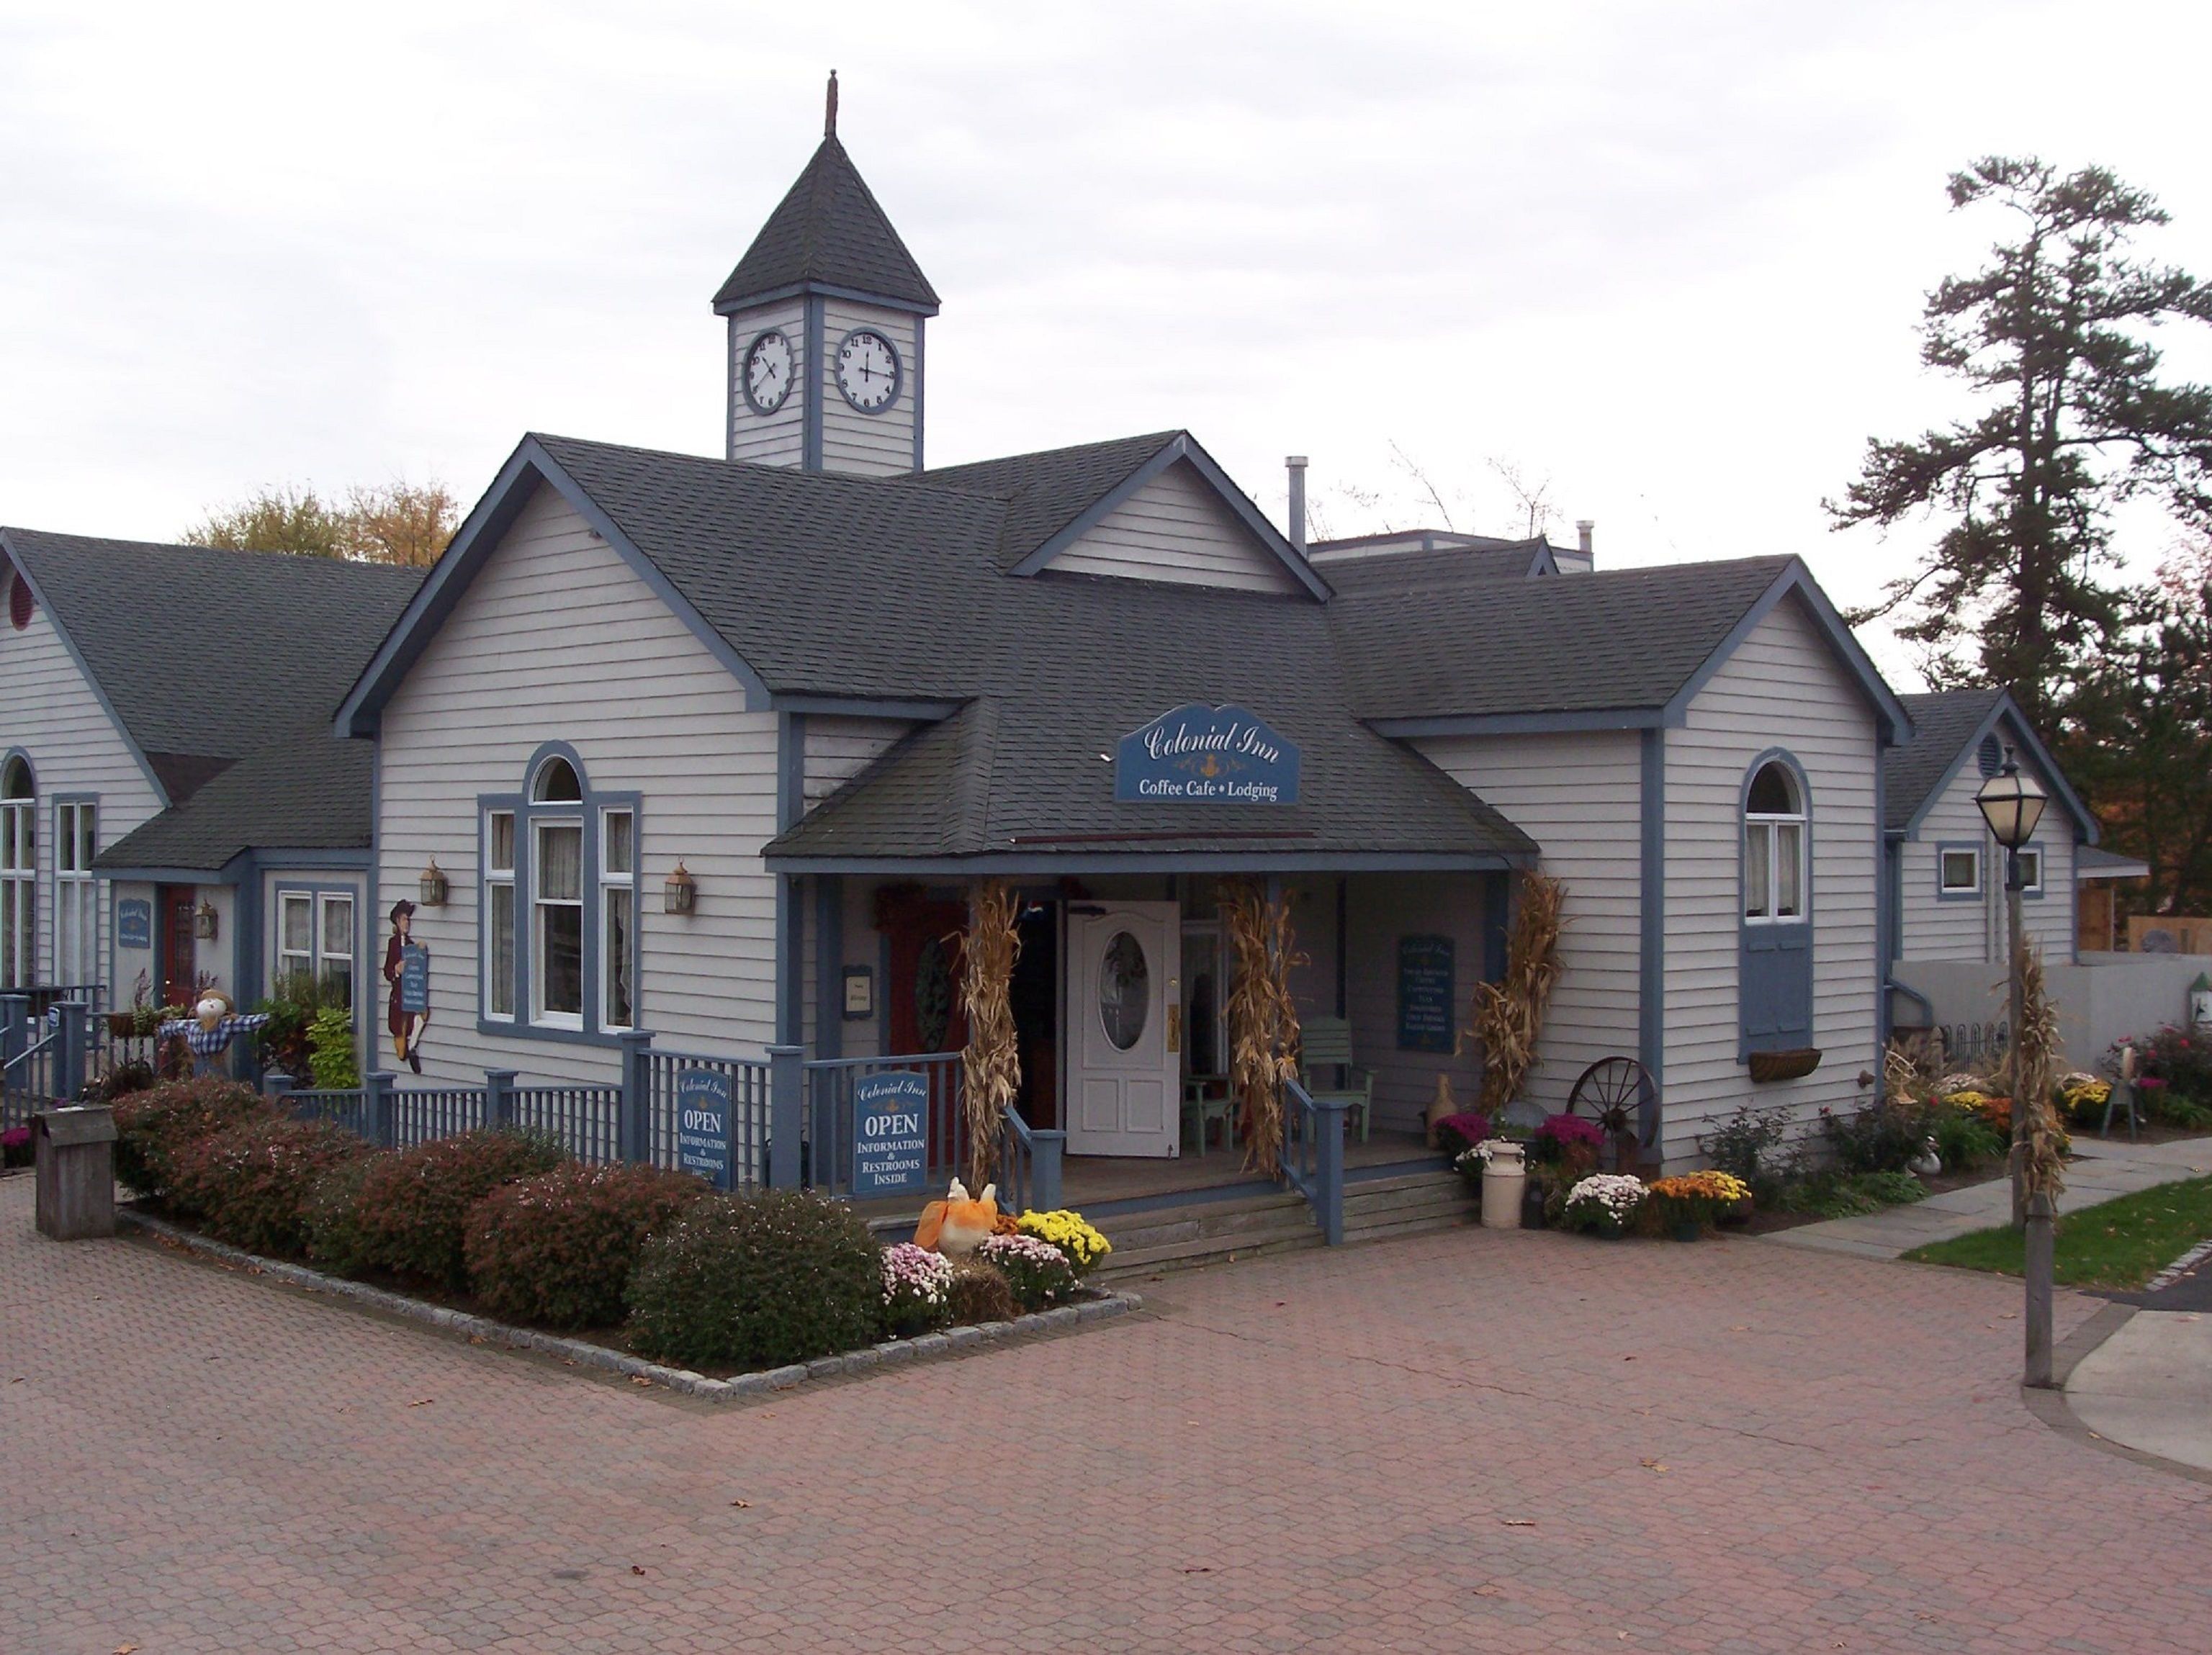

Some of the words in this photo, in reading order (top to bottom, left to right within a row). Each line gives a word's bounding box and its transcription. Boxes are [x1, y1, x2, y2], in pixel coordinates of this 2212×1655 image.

[851, 338, 858, 347] 11
[863, 335, 873, 345] 12
[878, 343, 882, 351] 1
[842, 349, 851, 358] 10
[885, 355, 891, 364] 2
[885, 385, 890, 394] 4
[851, 392, 857, 400] 7
[876, 395, 883, 404] 5
[863, 398, 870, 407] 6
[1144, 723, 1238, 759] Colonial
[1236, 726, 1279, 763] Inn
[1139, 779, 1183, 795] Coffee
[1187, 780, 1216, 795] Cafe
[1228, 782, 1278, 801] Lodging
[679, 1078, 711, 1093] Colonial
[710, 1081, 727, 1097] Inn
[857, 1081, 904, 1101] Colonial
[904, 1081, 927, 1096] Inn
[684, 1109, 721, 1133] OPEN
[865, 1114, 918, 1137] OPEN
[680, 1132, 726, 1150] INFORMATION
[857, 1139, 925, 1154] INFORMATION
[700, 1147, 706, 1156] &
[887, 1152, 895, 1160] &
[683, 1153, 724, 1170] RESTROOMS
[863, 1160, 920, 1173] RESTROOMS
[874, 1173, 907, 1186] INSIDE
